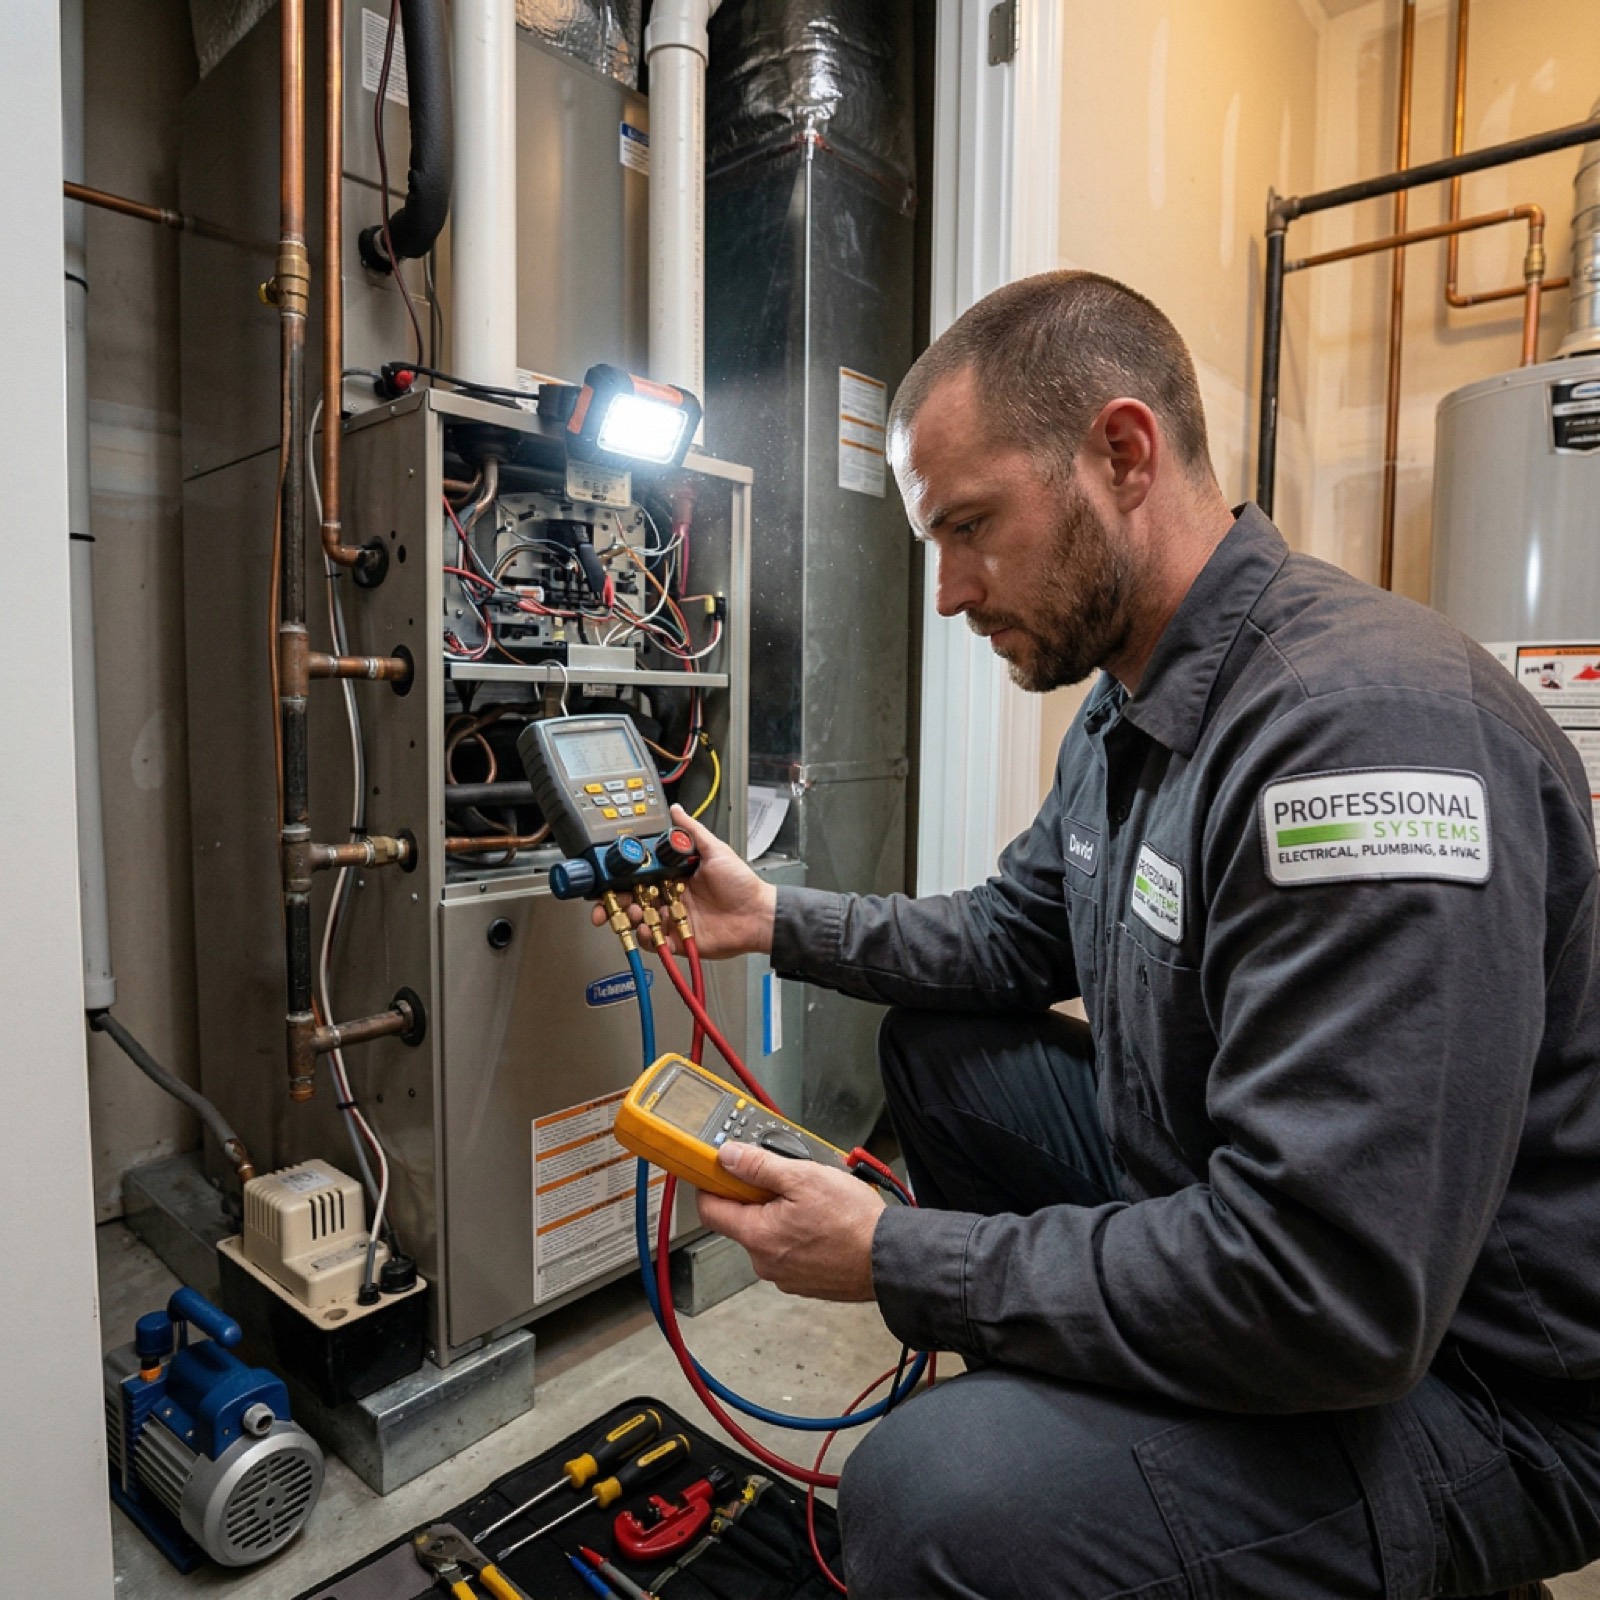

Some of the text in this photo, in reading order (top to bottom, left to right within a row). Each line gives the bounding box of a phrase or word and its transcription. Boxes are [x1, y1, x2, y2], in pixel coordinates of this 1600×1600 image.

[1274, 791, 1478, 825] PROFESSIONAL
[1373, 820, 1480, 843] SYSTEMS
[1278, 843, 1481, 864] ELECTRICAL, PLUMBING, & HVAC
